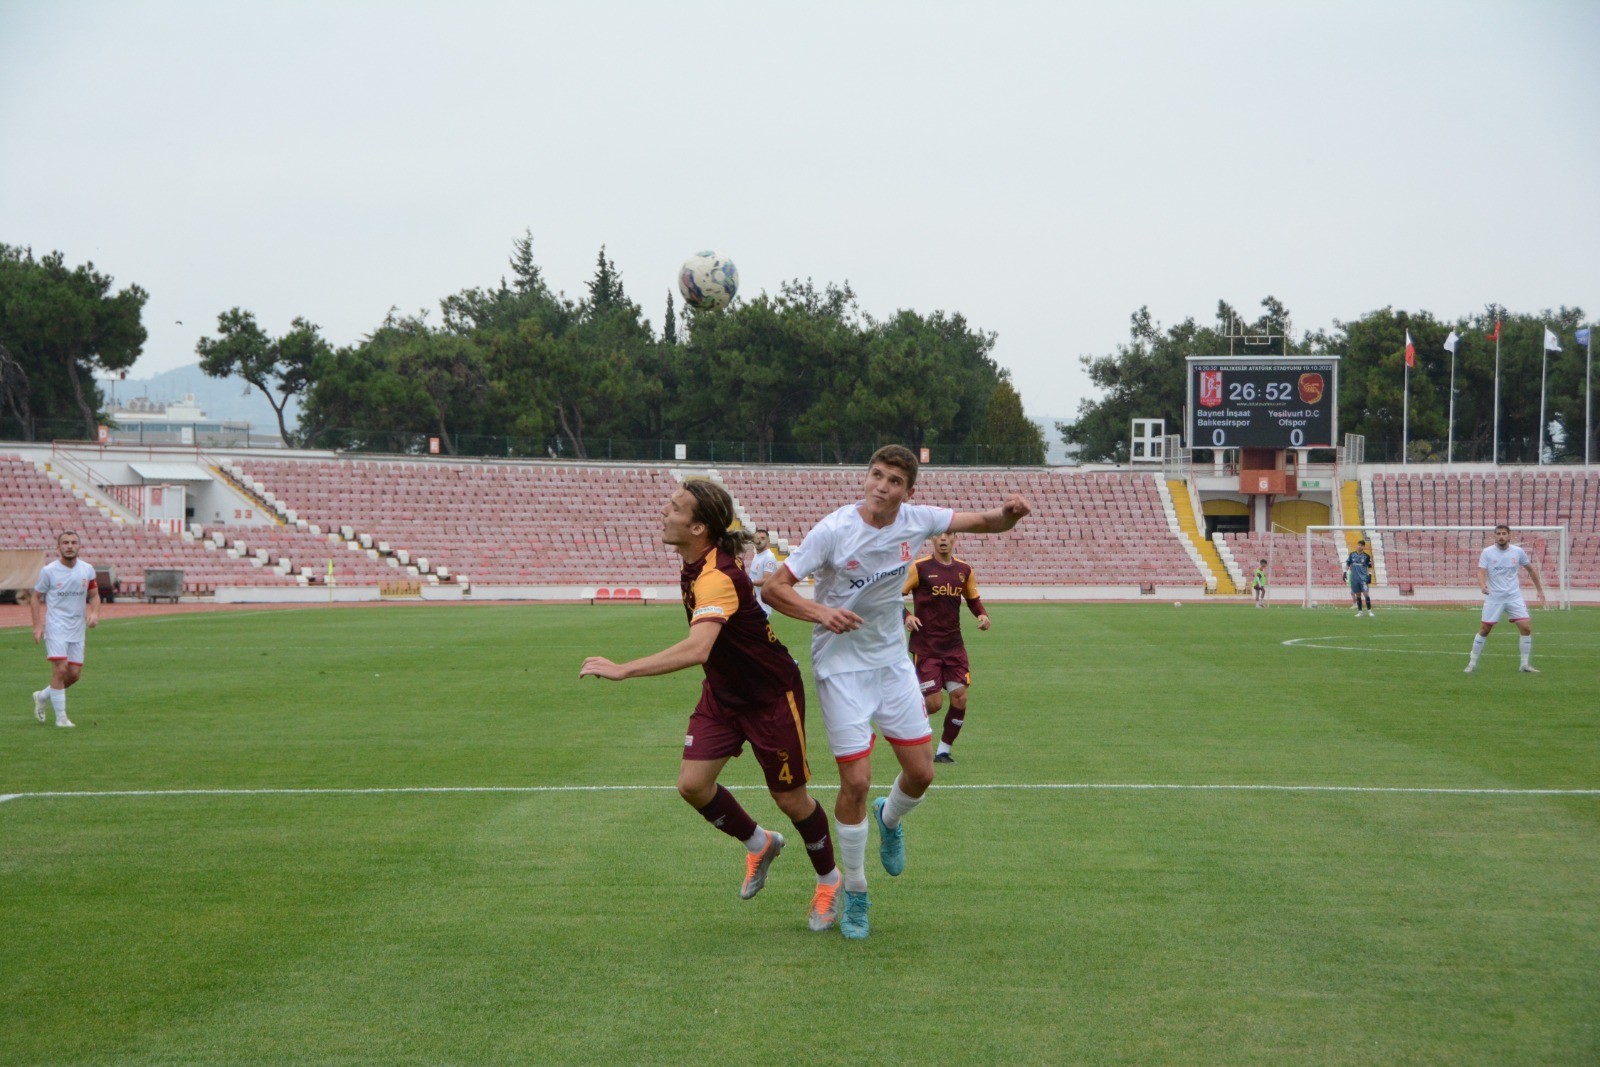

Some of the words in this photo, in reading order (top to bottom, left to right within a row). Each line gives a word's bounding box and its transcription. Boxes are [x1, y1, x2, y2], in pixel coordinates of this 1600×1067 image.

[1197, 409, 1225, 418] Baynet
[1278, 418, 1307, 428] Ofspor
[1212, 428, 1225, 446] 0
[1290, 428, 1304, 446] 0
[1260, 480, 1268, 489] G
[931, 582, 963, 597] seluz
[778, 762, 794, 785] 4
